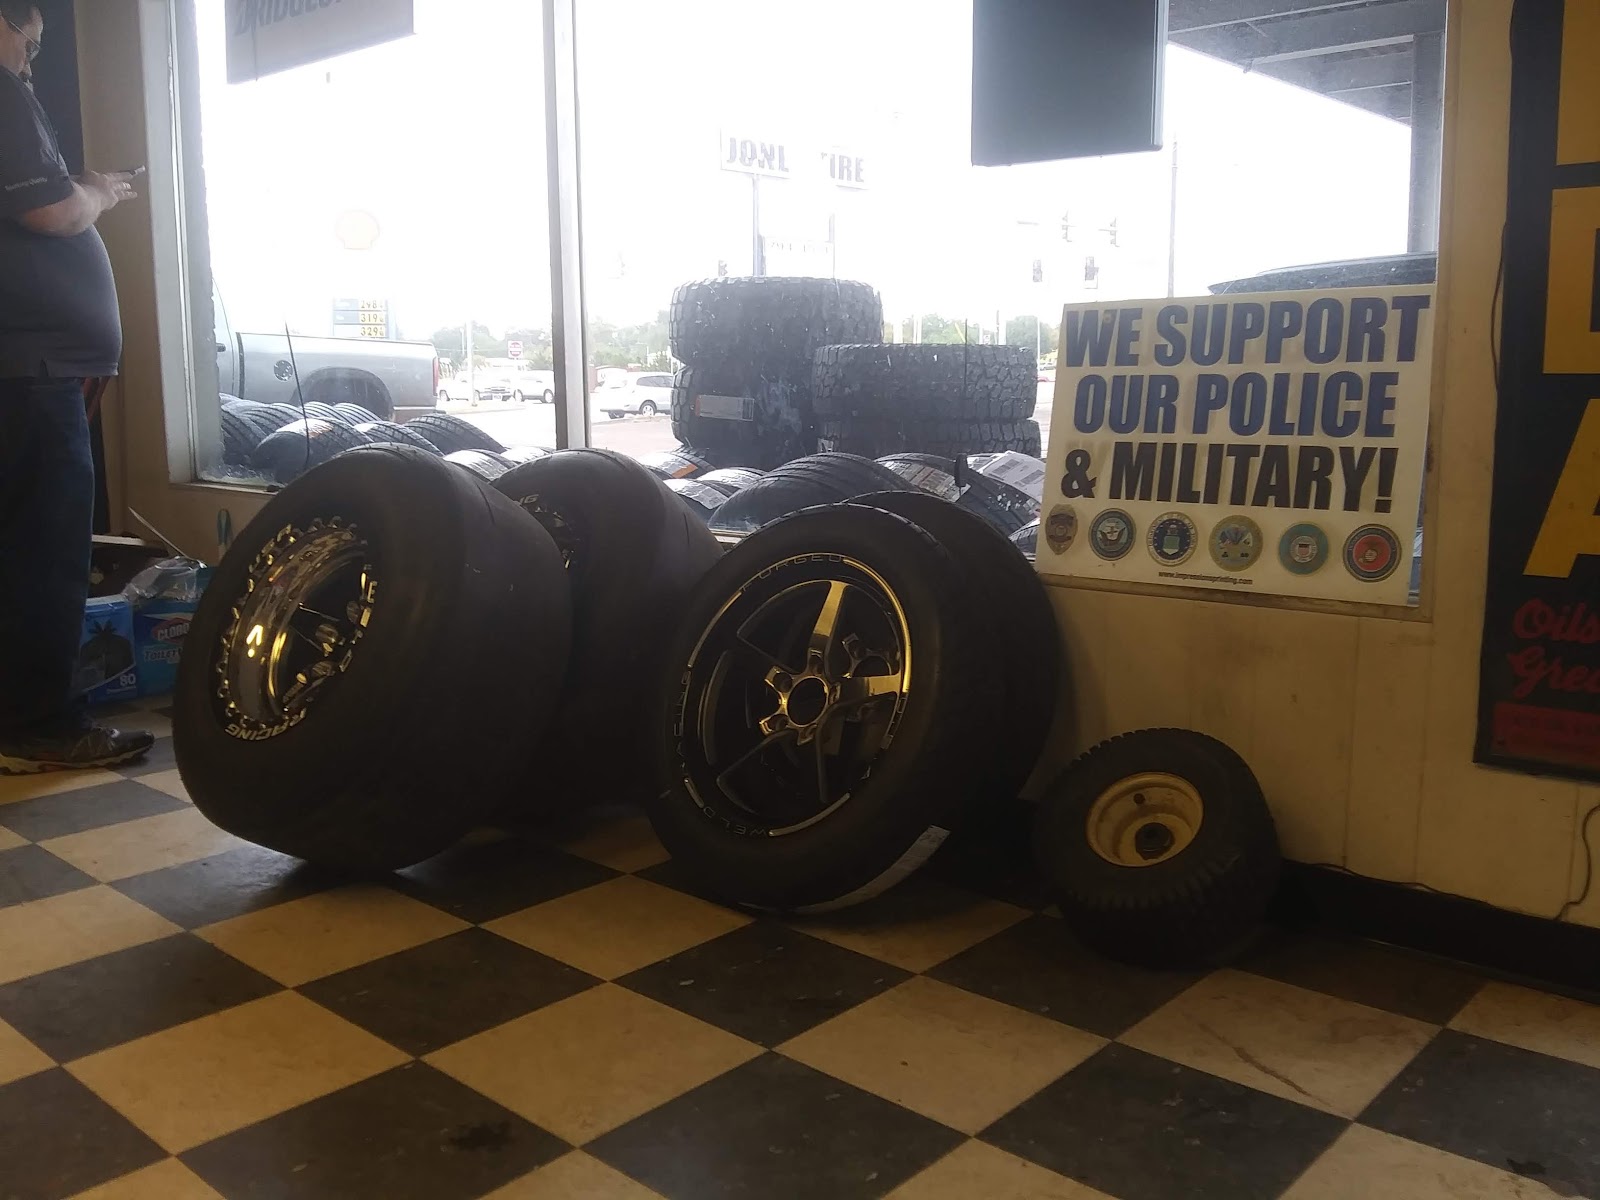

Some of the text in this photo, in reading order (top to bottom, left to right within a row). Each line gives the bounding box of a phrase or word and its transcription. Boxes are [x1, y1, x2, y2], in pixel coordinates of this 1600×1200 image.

[1065, 295, 1431, 368] WE SUPPORT
[1073, 371, 1400, 438] OUR POLICE
[1061, 449, 1097, 499] &
[1108, 441, 1399, 513] MILITARY!
[157, 622, 190, 641] CLORO
[120, 673, 136, 687] 80
[703, 806, 767, 837] WELD
